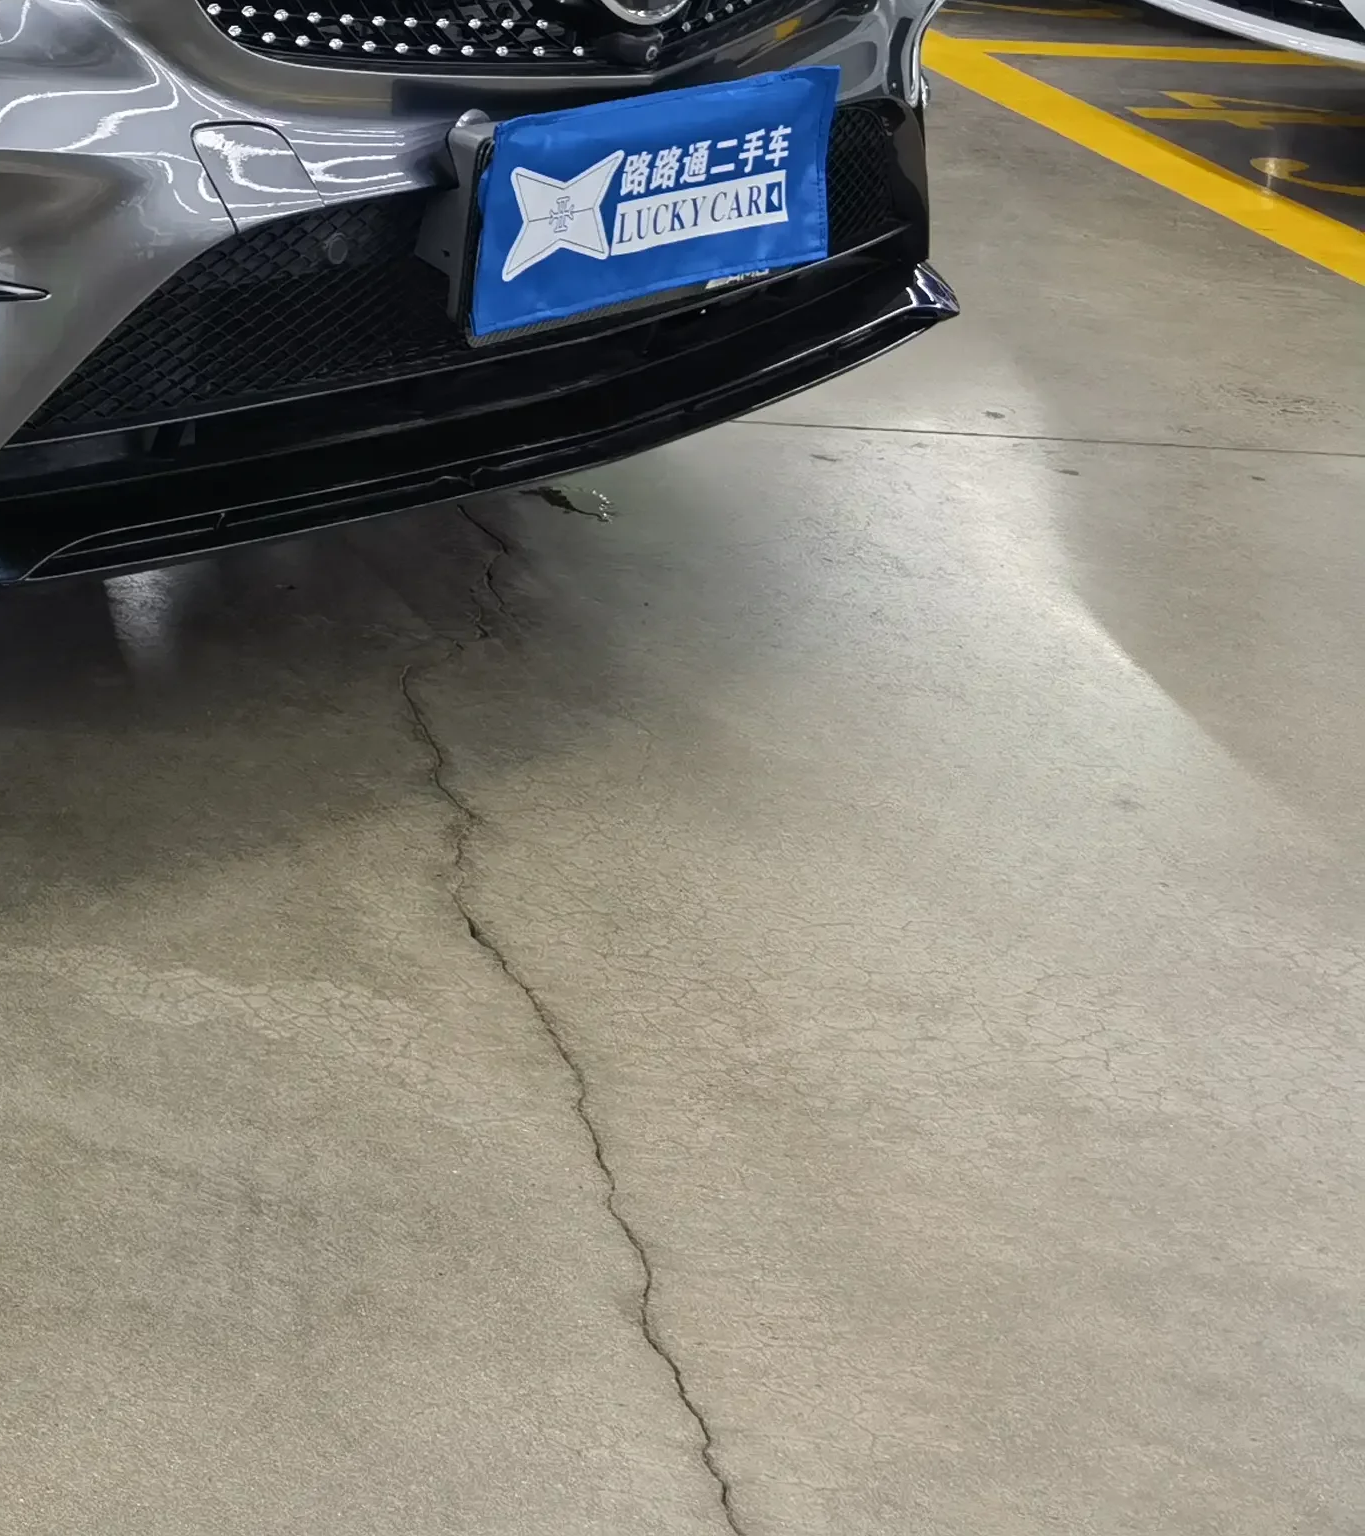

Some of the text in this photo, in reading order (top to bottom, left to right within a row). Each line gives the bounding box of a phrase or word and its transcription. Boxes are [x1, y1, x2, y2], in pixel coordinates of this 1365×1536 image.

[620, 124, 793, 197] 路路通二手车
[615, 185, 763, 244] LUCKY CAR
